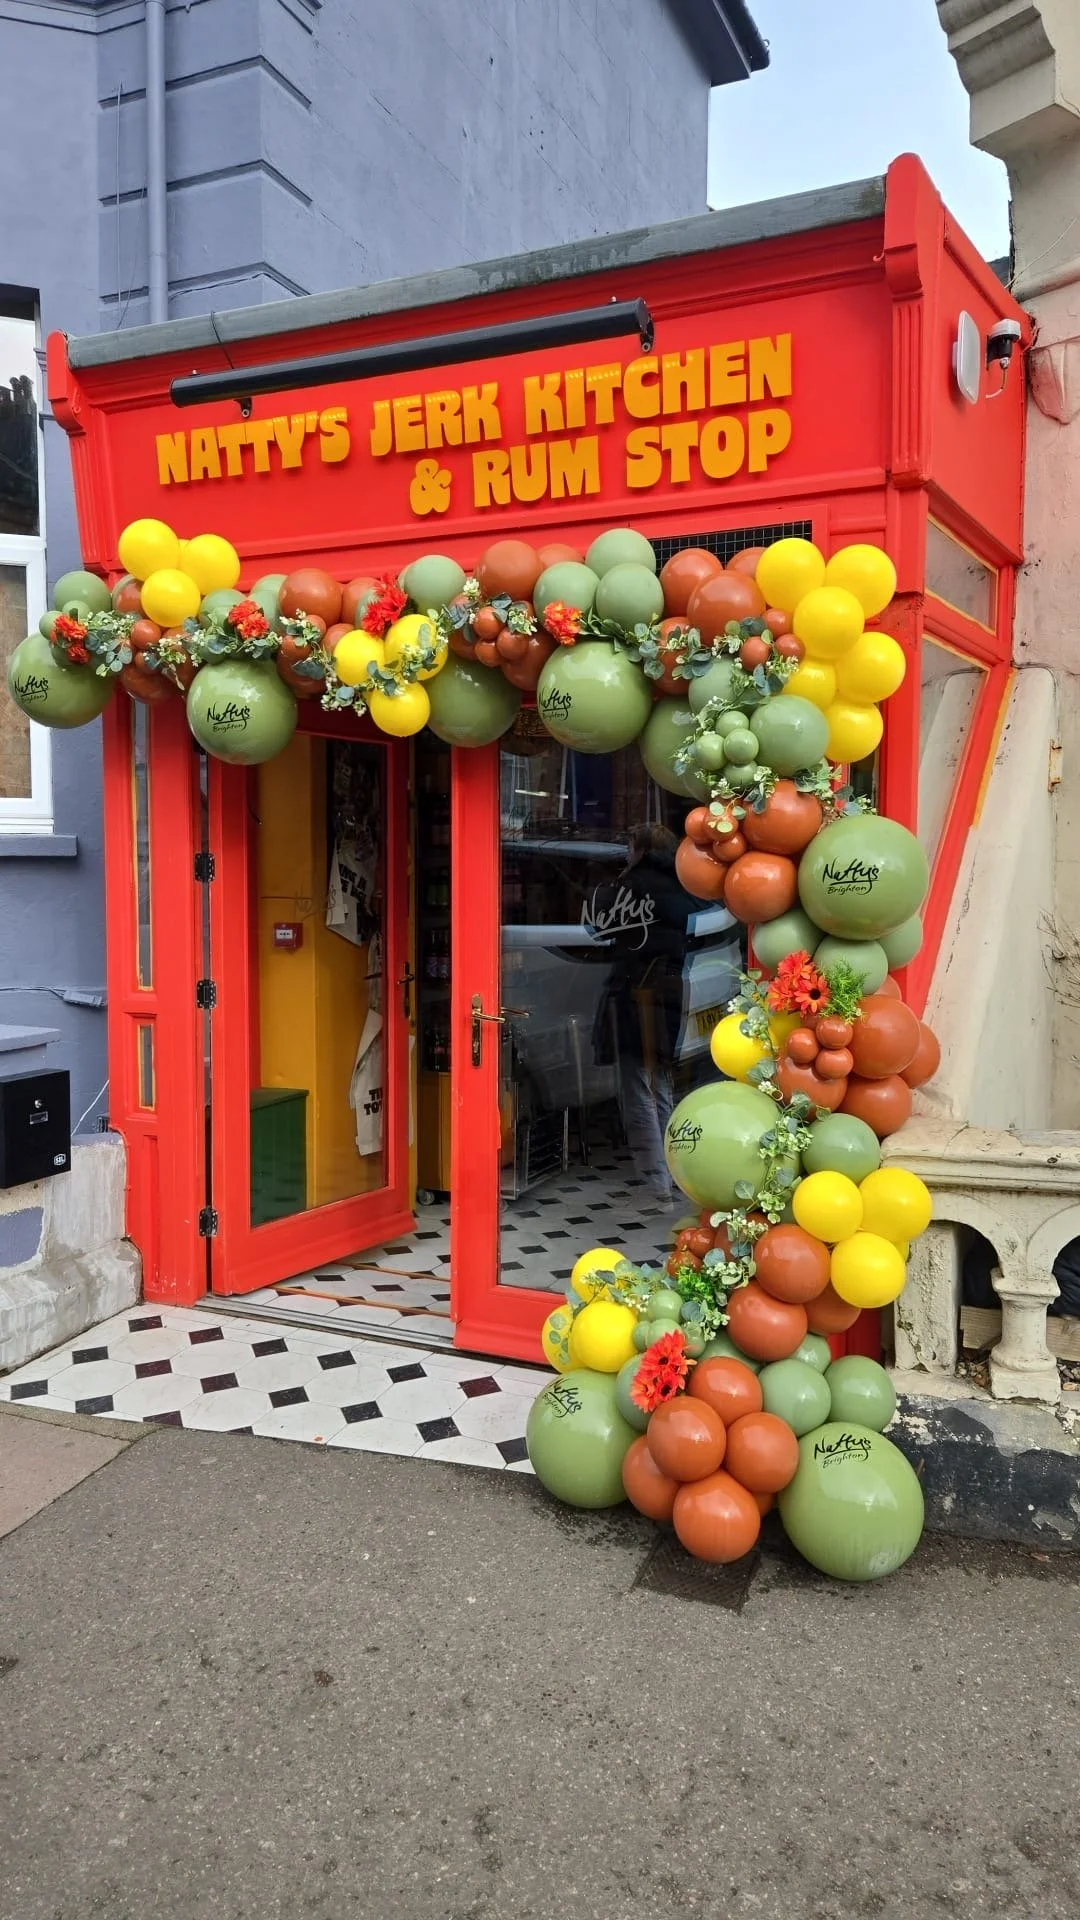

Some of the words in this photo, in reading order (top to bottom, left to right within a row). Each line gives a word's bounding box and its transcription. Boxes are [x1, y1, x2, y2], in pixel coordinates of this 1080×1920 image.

[156, 408, 350, 486] NATTY'S
[369, 382, 501, 457] JERK
[523, 333, 794, 436] KITCHEN
[408, 458, 453, 517] &
[472, 437, 602, 508] RUM
[625, 408, 794, 488] STOP
[14, 674, 49, 702] Natty's
[206, 702, 251, 731] Natty's
[822, 856, 880, 896] Natty's
[827, 884, 867, 896] Brighton
[580, 882, 661, 951] Natty's
[814, 1433, 873, 1461] Natty's
